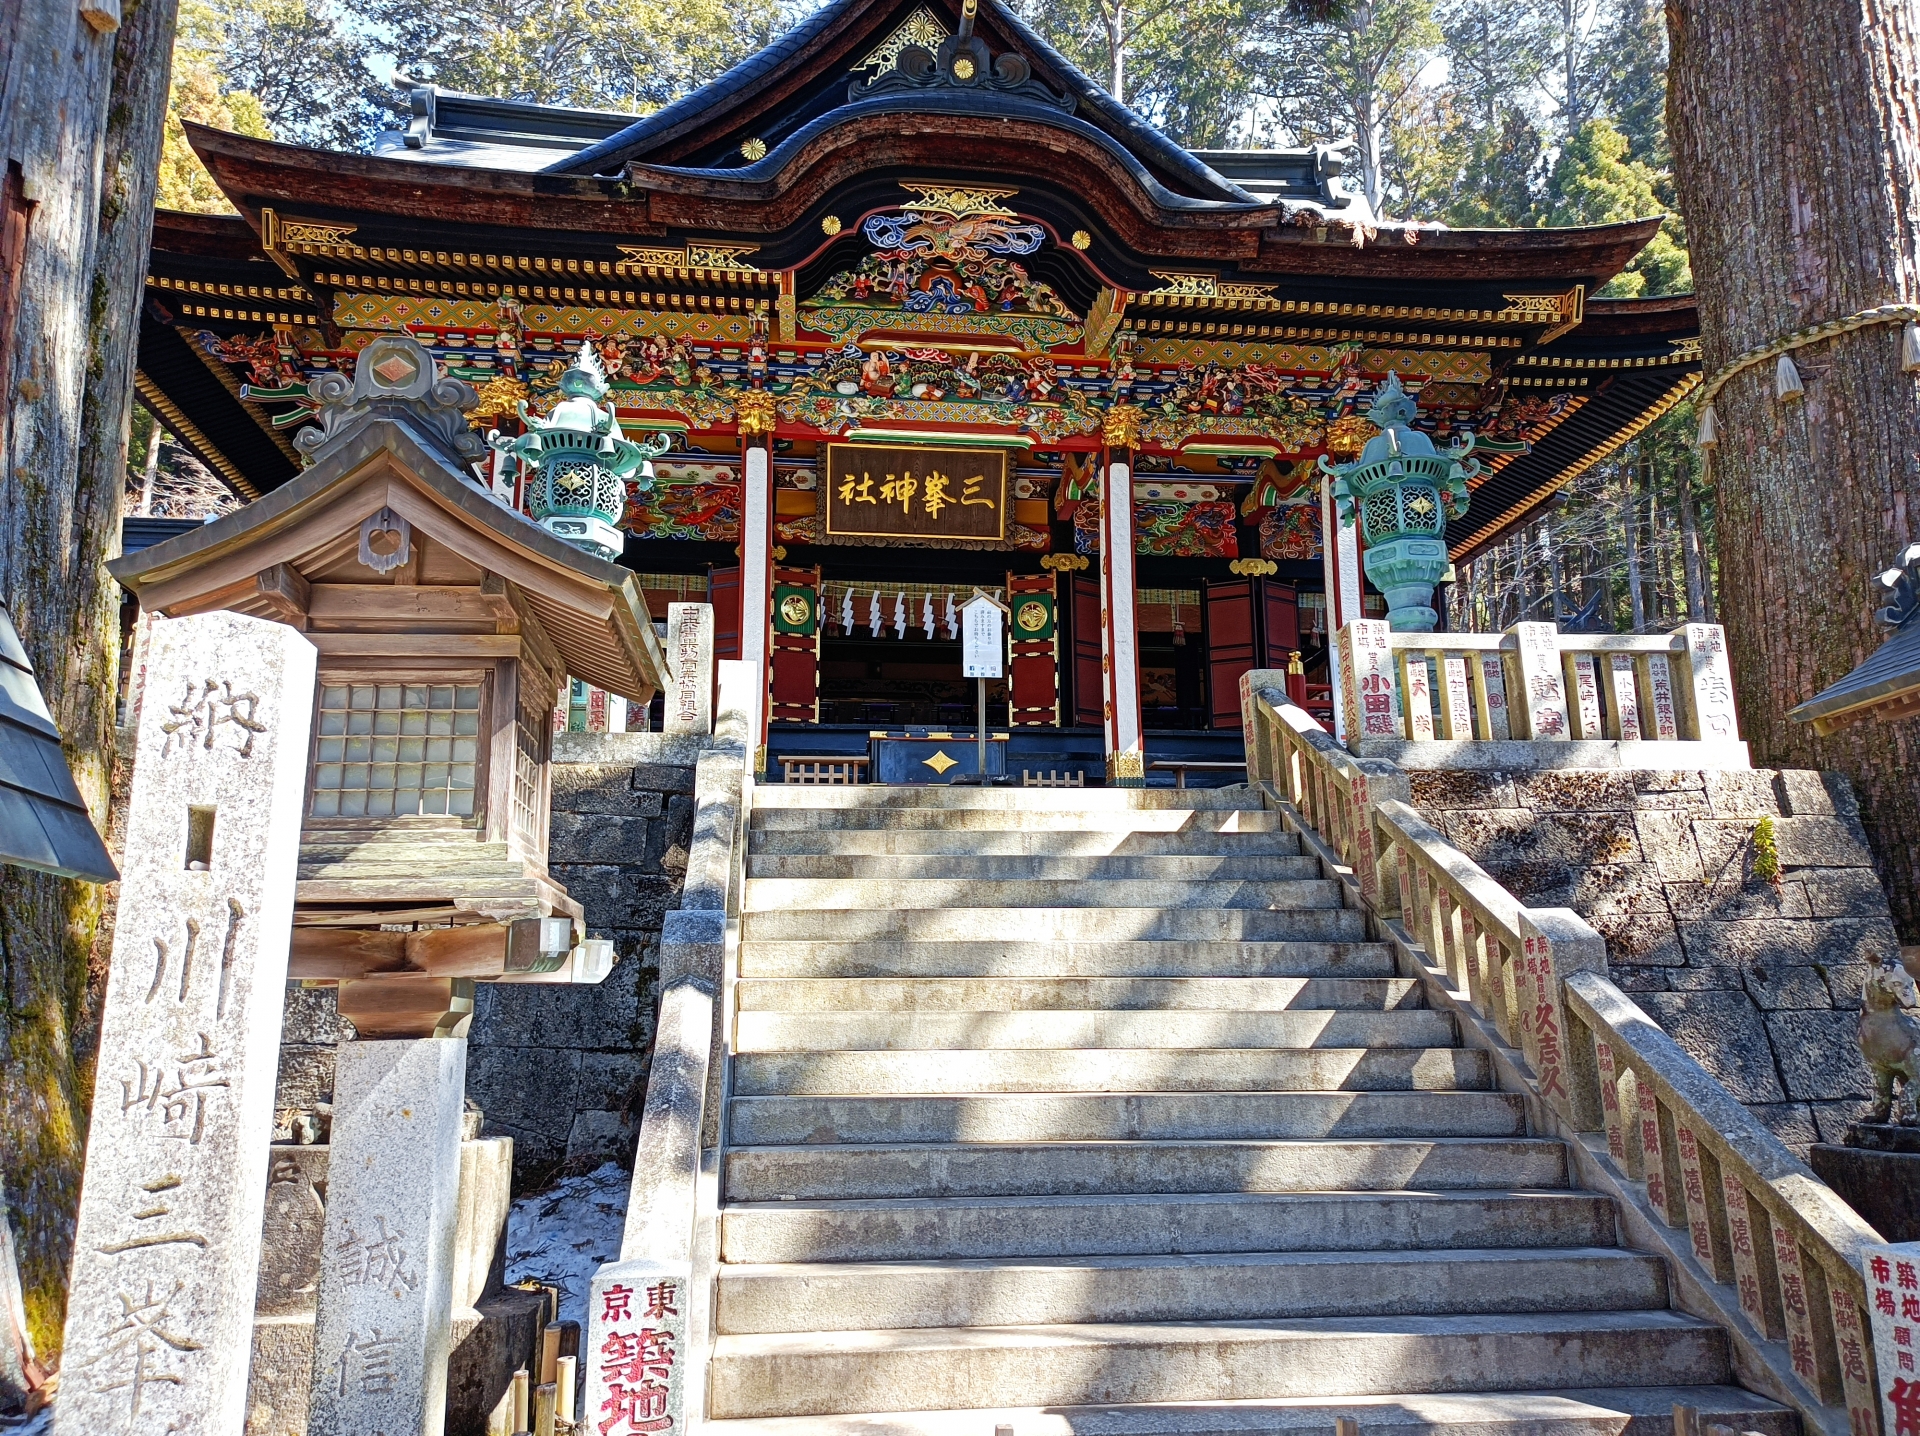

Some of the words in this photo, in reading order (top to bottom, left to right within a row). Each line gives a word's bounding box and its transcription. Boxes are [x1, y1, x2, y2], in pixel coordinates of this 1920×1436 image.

[1524, 936, 1537, 976] 市場
[1537, 935, 1551, 976] 築地
[336, 1212, 417, 1397] 誠信
[1894, 1325, 1915, 1373] 顧問
[597, 1327, 676, 1435] 築地
